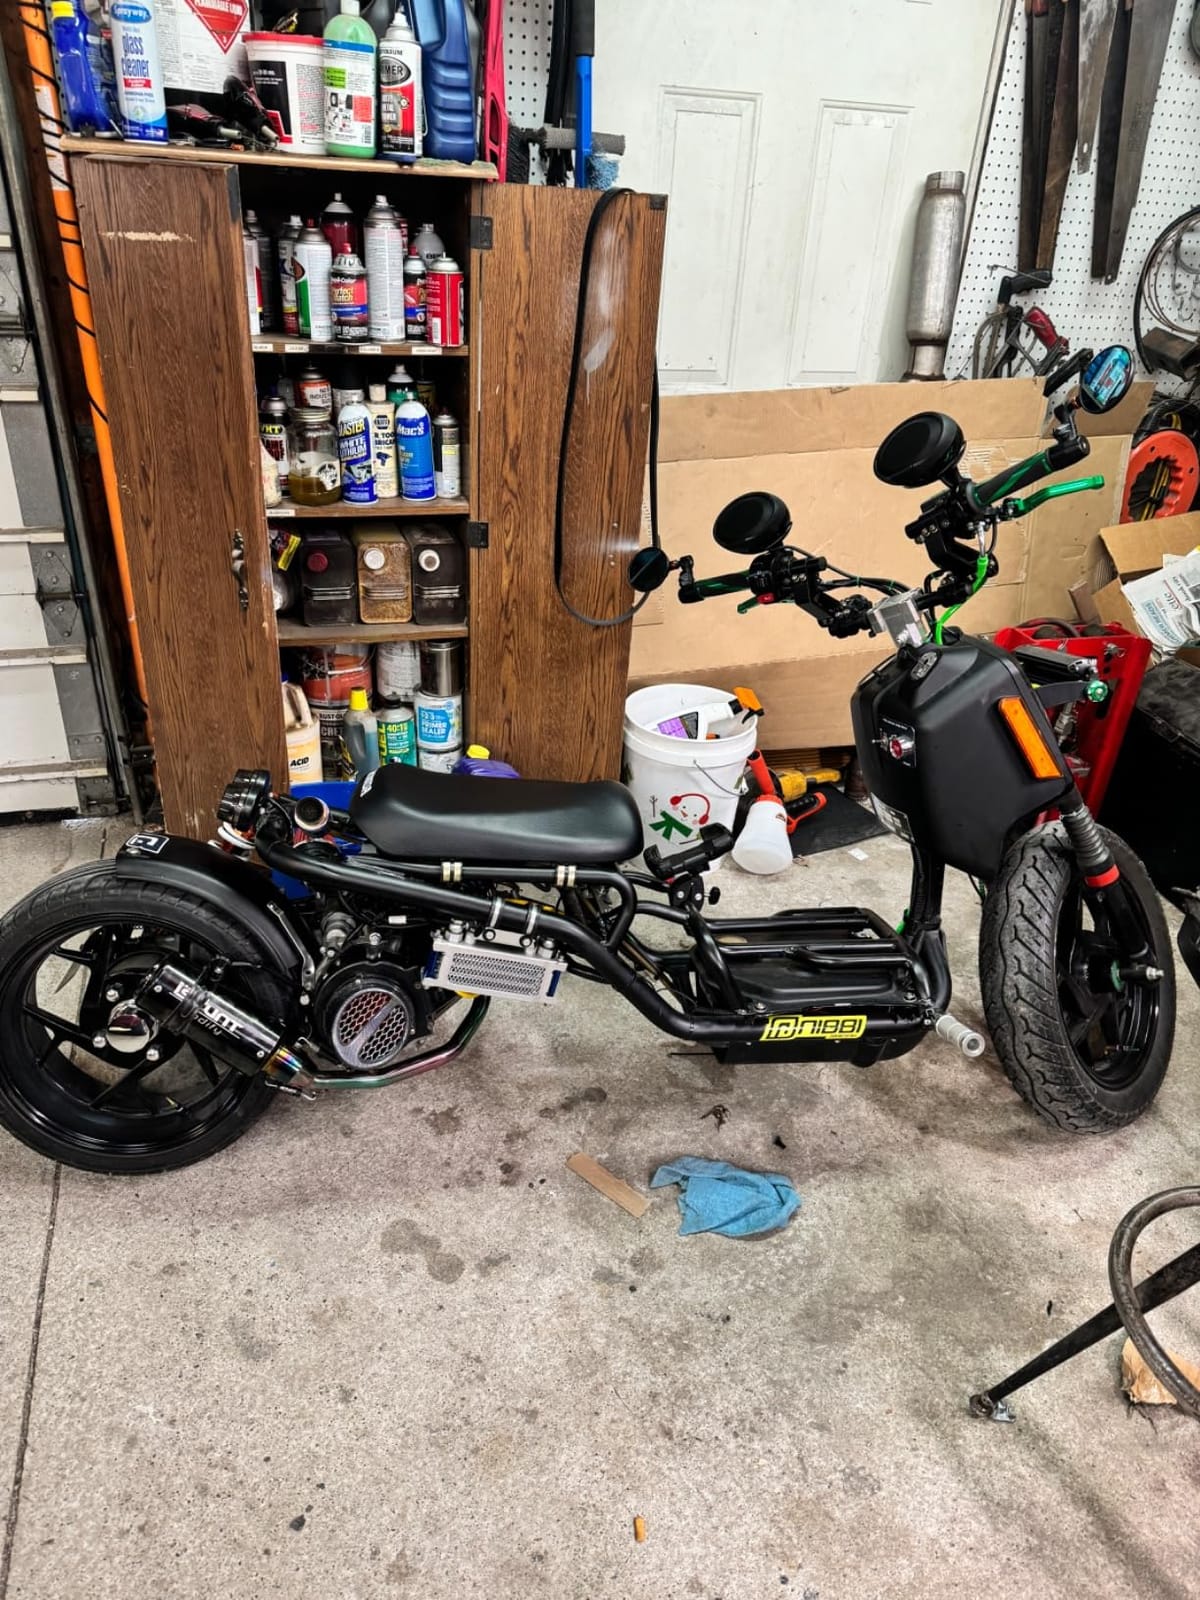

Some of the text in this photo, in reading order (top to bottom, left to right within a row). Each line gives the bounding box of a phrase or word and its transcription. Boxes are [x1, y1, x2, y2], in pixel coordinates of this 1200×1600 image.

[122, 33, 144, 57] glass
[121, 57, 150, 77] cleaner
[290, 757, 309, 767] ACID
